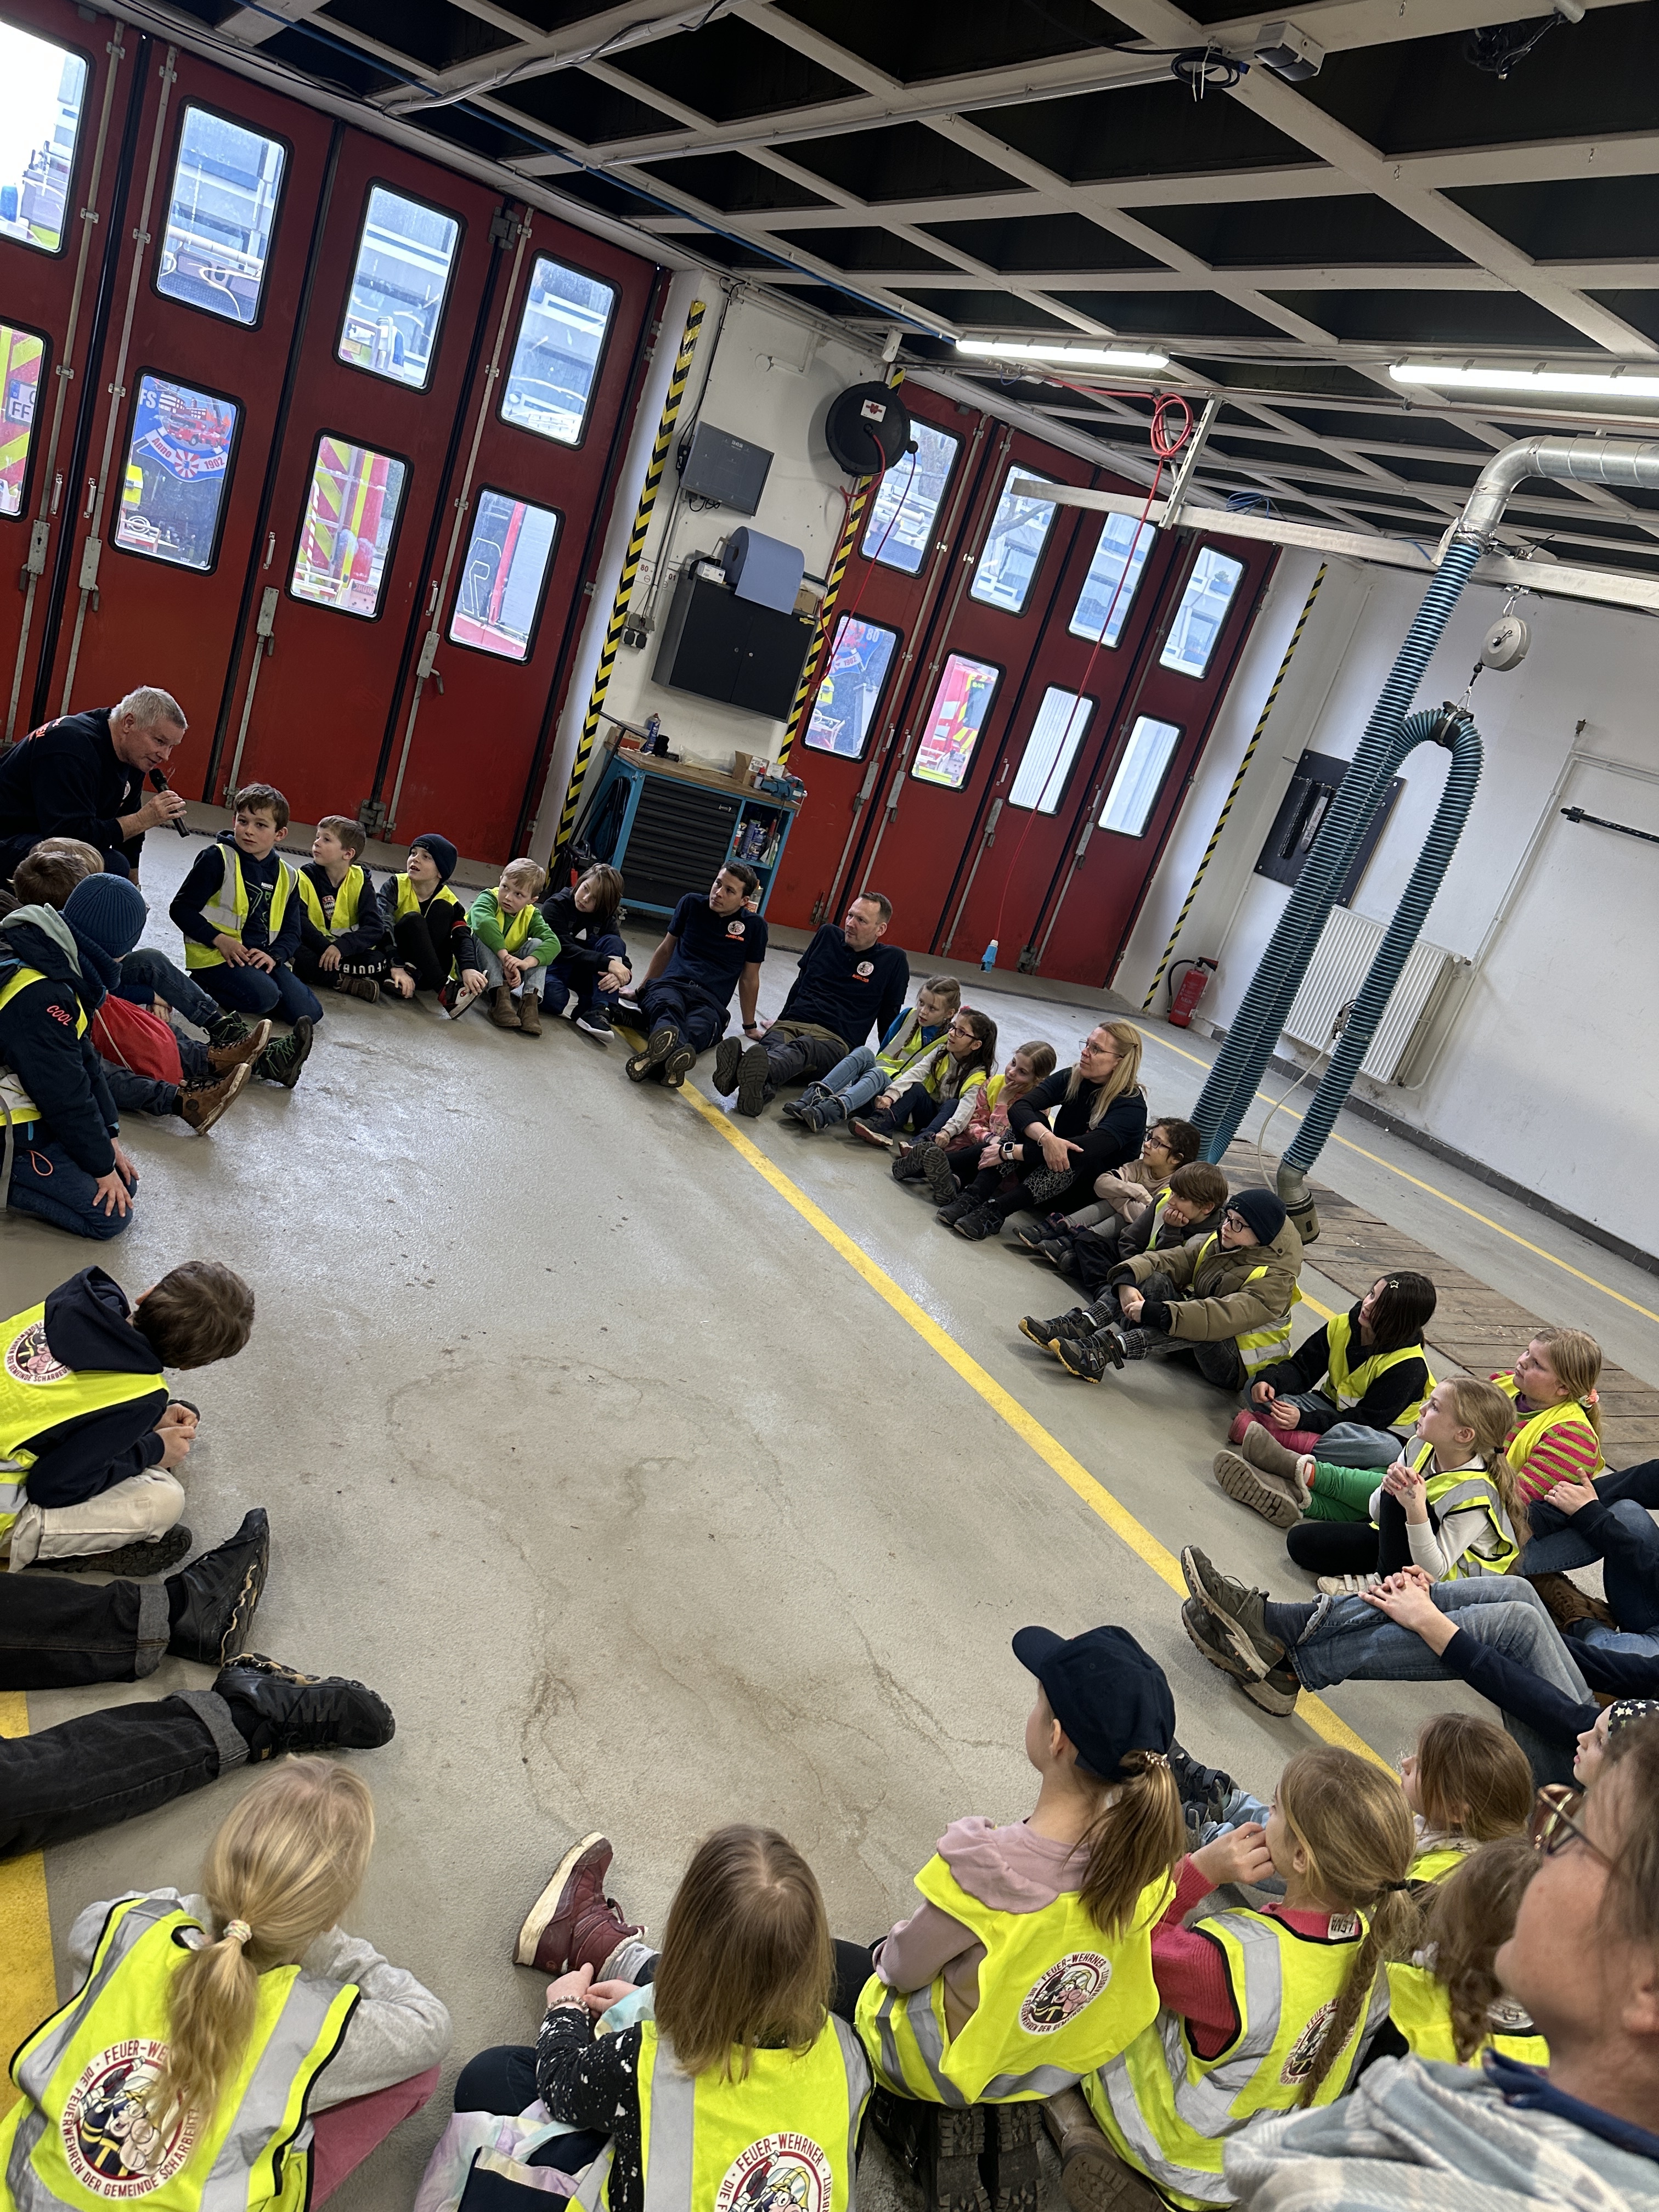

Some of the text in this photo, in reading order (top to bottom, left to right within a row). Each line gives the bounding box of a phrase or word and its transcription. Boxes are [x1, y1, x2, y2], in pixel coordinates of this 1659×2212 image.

[12, 401, 31, 418] FF
[204, 456, 224, 470] 1902
[640, 564, 676, 582] 80 01
[866, 628, 880, 642] 80
[844, 656, 857, 667] 1902
[46, 1005, 73, 1026] COOL
[80, 2066, 95, 2084] DIE
[62, 2087, 84, 2174] FEUERWEHREN
[735, 2133, 824, 2172] FEUER-WEHRNER
[82, 2171, 103, 2192] DER
[104, 2176, 160, 2197] GEMEINDE
[719, 2179, 735, 2200] DIE
